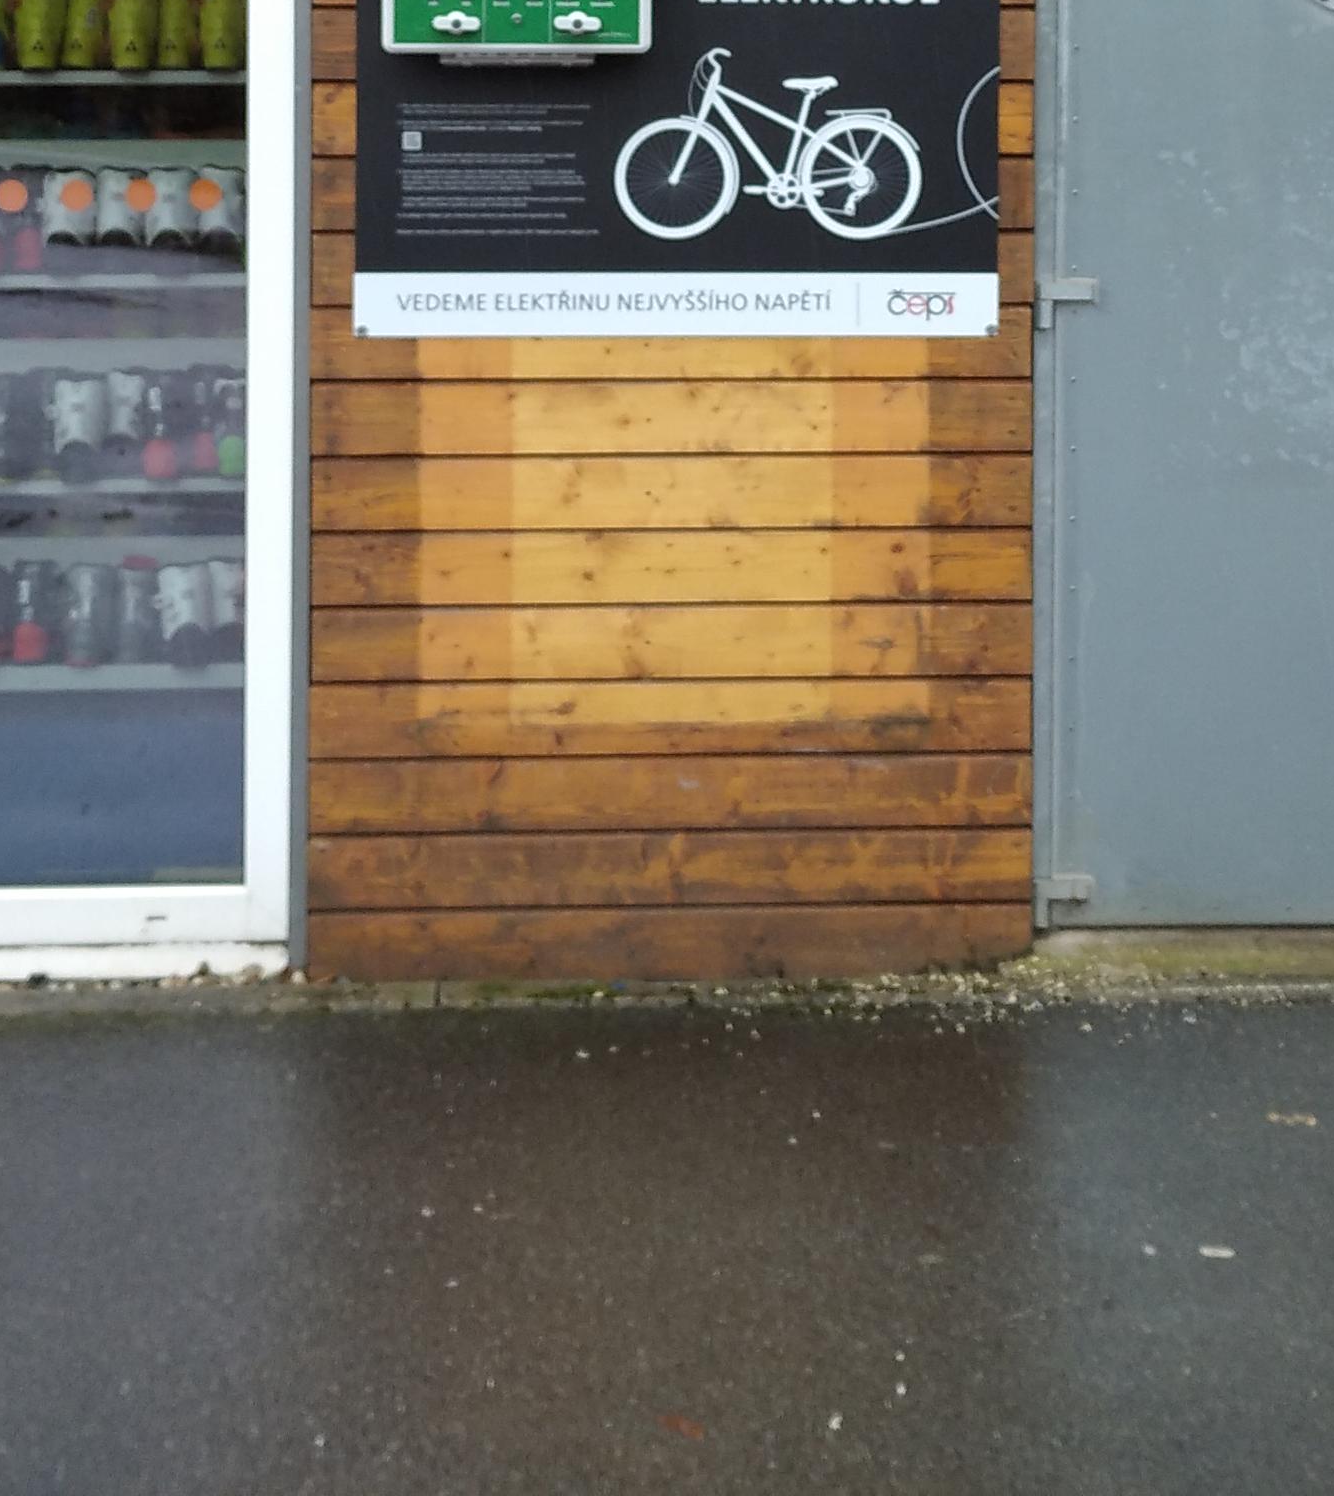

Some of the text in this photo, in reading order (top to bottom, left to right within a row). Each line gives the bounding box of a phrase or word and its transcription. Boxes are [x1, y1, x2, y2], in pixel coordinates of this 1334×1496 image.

[397, 289, 831, 312] VEDEME ELEKTŘINU NEJVYŠŠÍHO NAPĚTÍ
